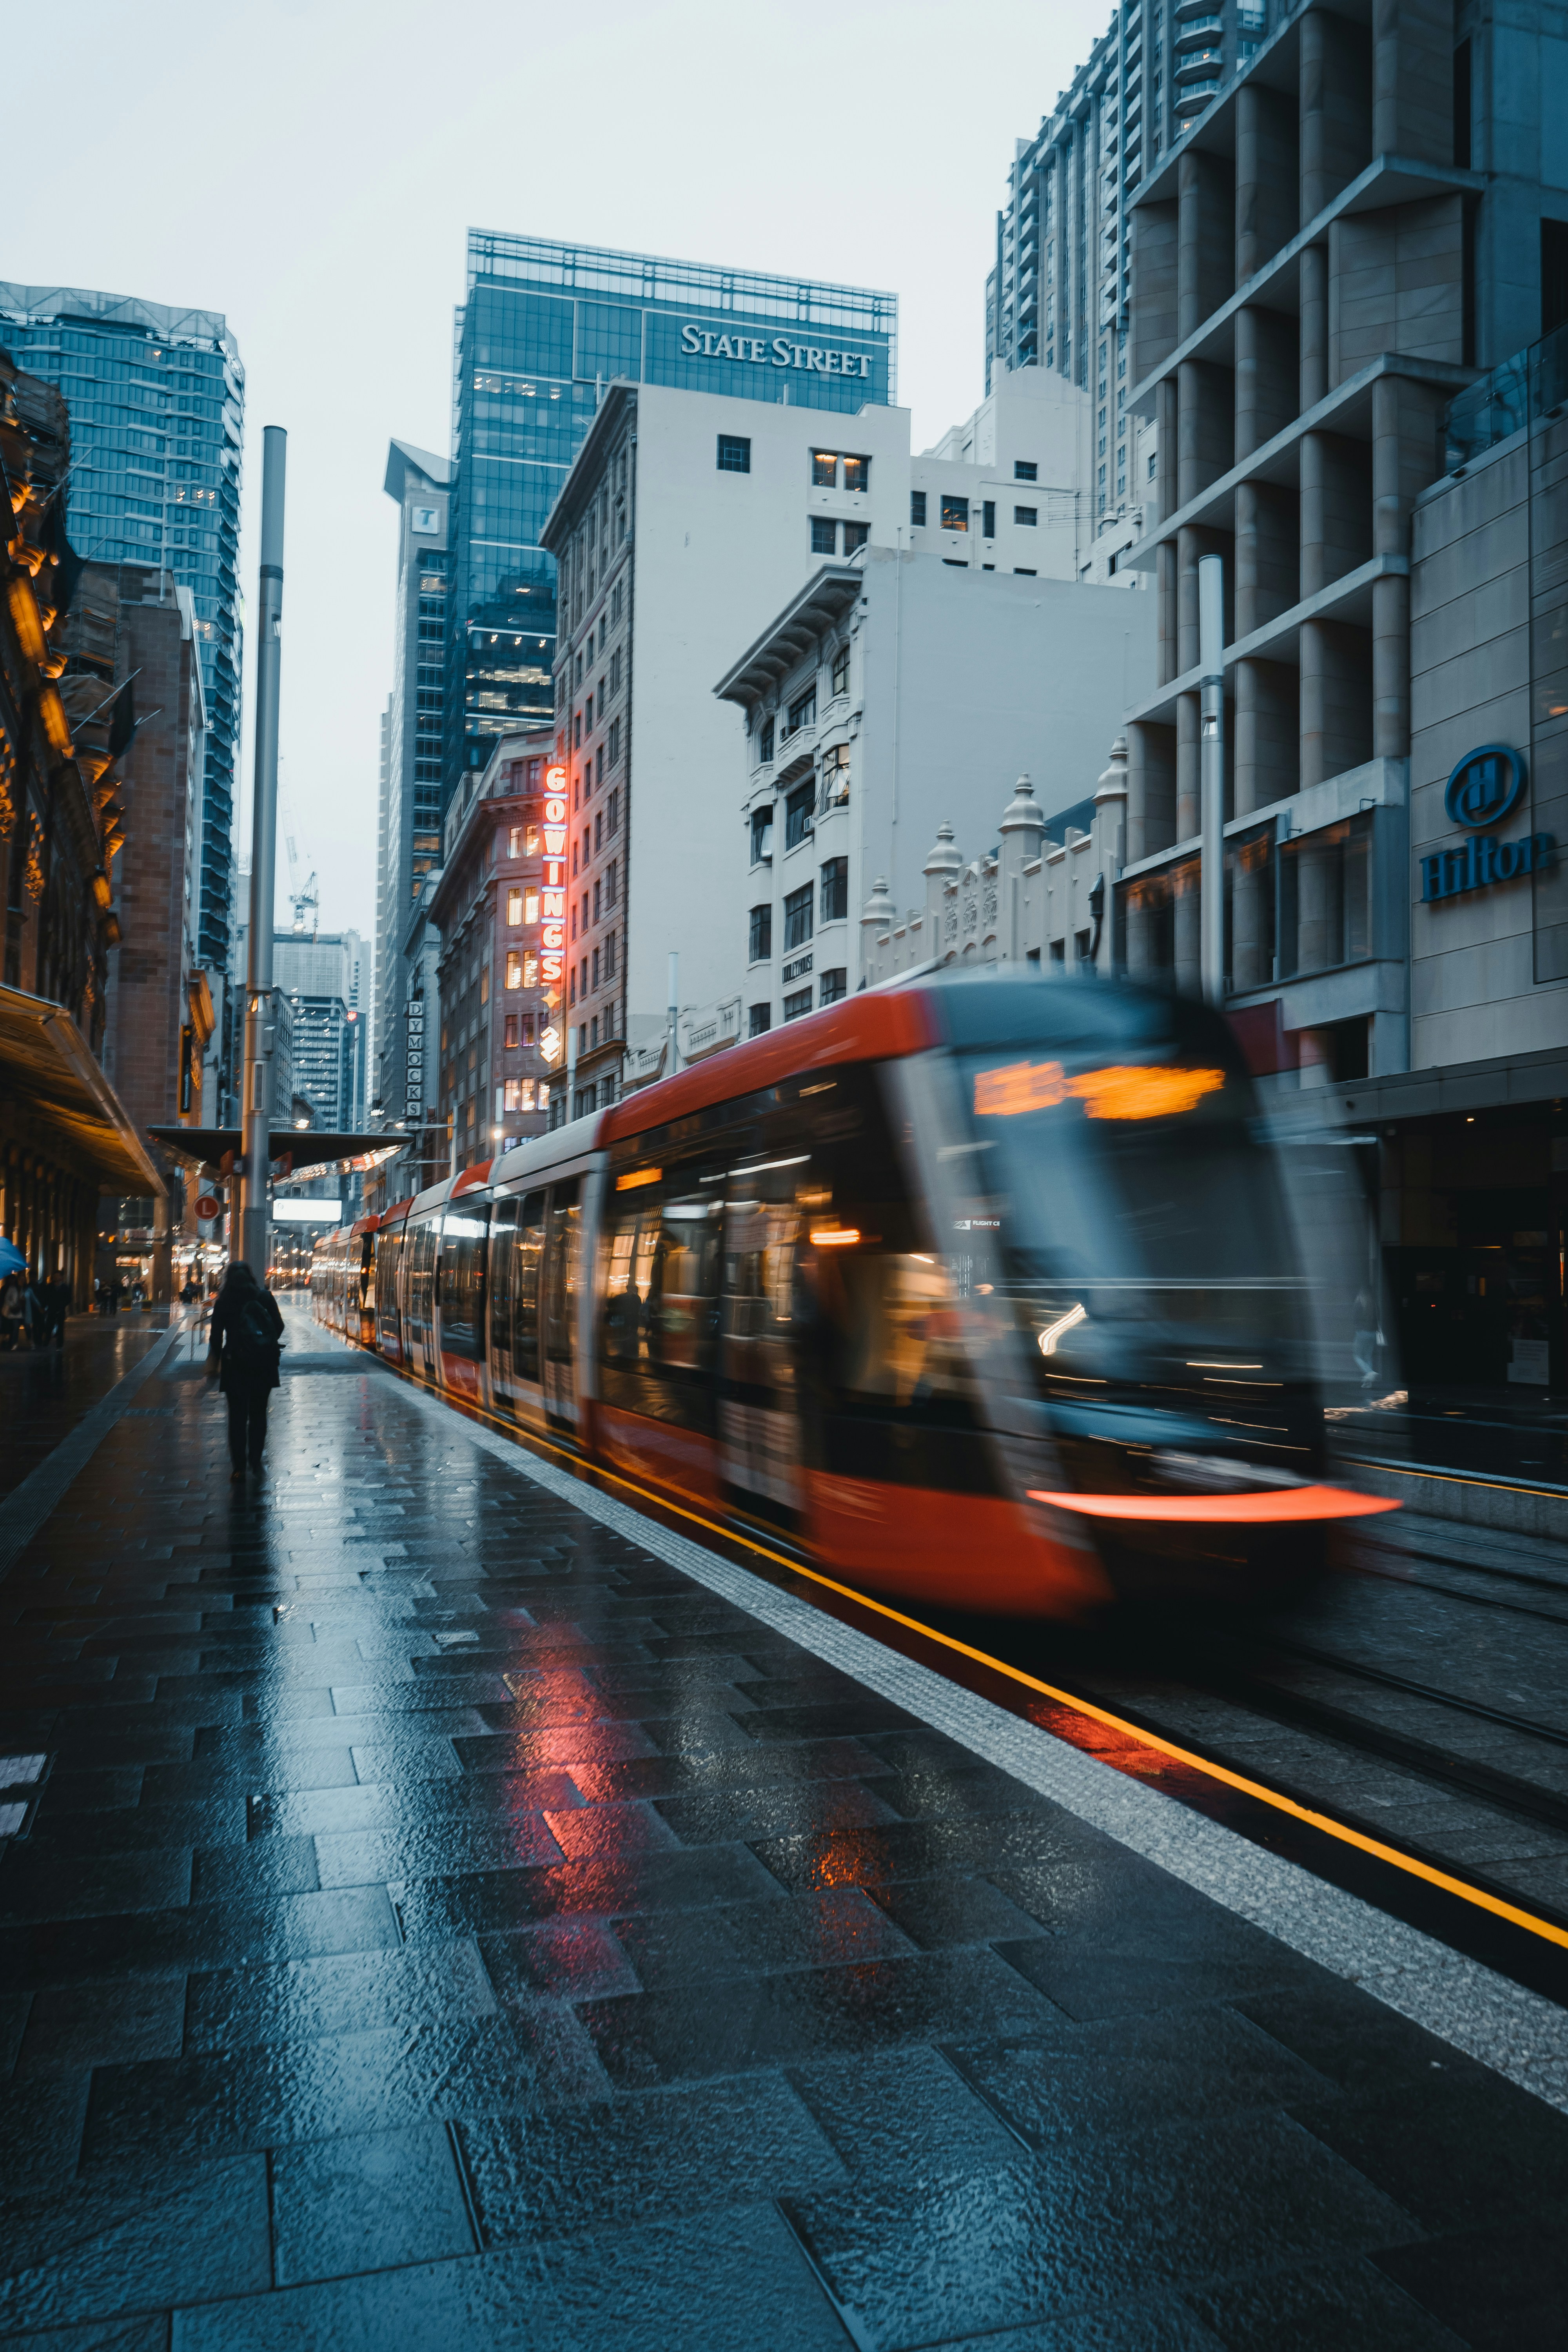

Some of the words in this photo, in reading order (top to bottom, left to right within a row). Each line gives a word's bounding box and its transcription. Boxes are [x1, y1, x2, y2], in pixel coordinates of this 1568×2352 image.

[681, 325, 767, 363] STATE
[771, 338, 874, 377] STREET
[419, 509, 435, 526] T
[543, 767, 566, 980] GOWINGS
[1419, 833, 1557, 904] Hilton
[408, 1004, 421, 1114] DYMOCKS
[201, 1201, 212, 1215] L
